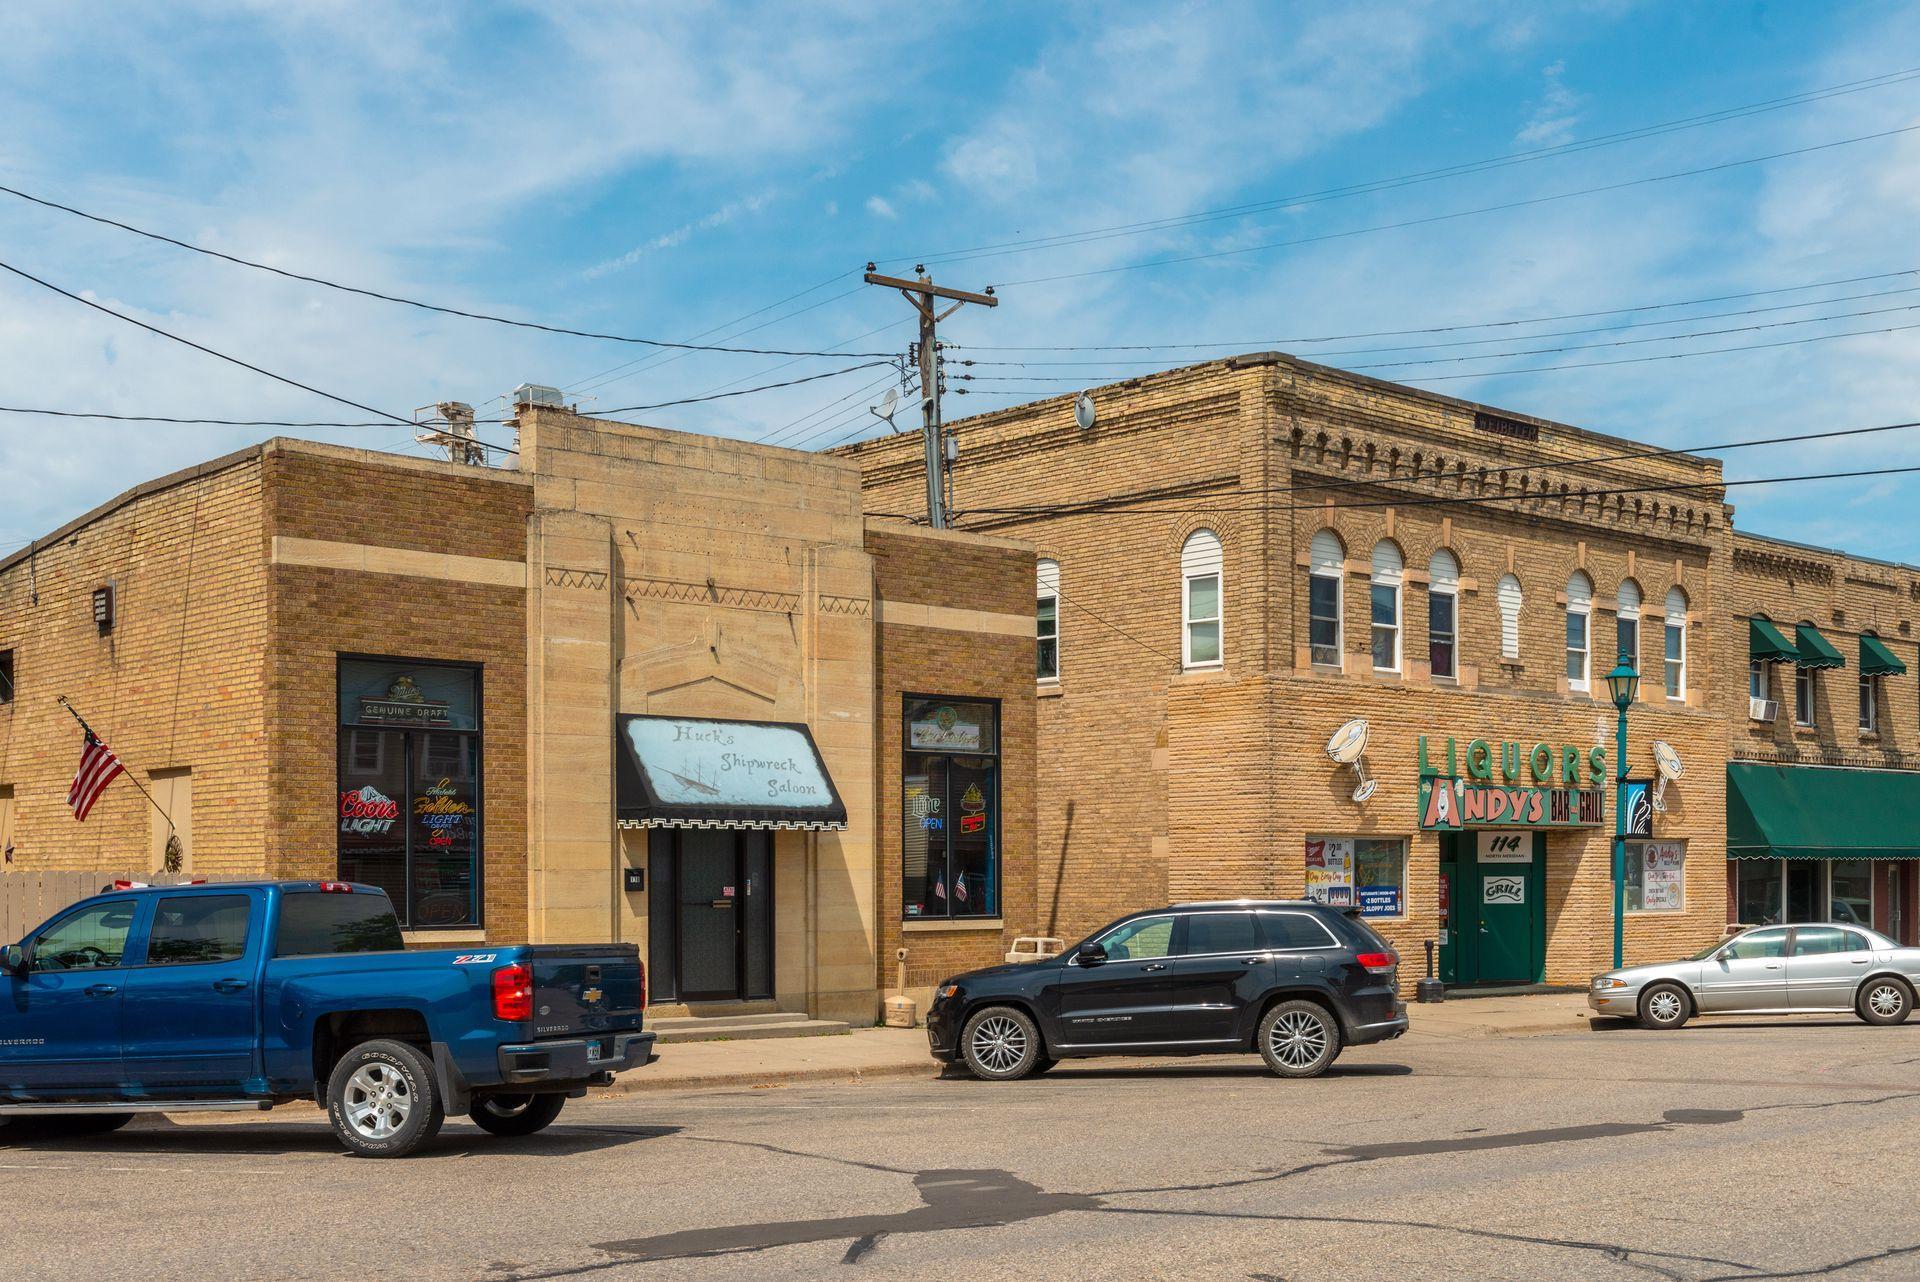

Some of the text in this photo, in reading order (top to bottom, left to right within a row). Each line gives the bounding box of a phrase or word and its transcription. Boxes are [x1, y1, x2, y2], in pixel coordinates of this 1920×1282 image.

[365, 705, 448, 717] GENUINE DRAFT
[672, 725, 735, 746] Huck's
[720, 753, 803, 775] Shipwreck
[1418, 735, 1607, 783] LIQUORS
[767, 778, 816, 797] Saloon
[340, 789, 400, 819] Coors
[912, 795, 941, 818] Lite
[341, 818, 396, 833] LIGHT
[421, 814, 463, 824] LIGHT
[920, 817, 943, 830] OPEN
[428, 837, 452, 846] OPEN
[1490, 835, 1522, 852] 114
[1327, 858, 1344, 866] BOTTLES
[1485, 884, 1522, 898] GRILL
[452, 953, 497, 965] Z71
[536, 1024, 569, 1033] SILVERADO
[361, 1052, 419, 1103] GOODYEAR
[333, 1101, 388, 1149] WRANGLER
